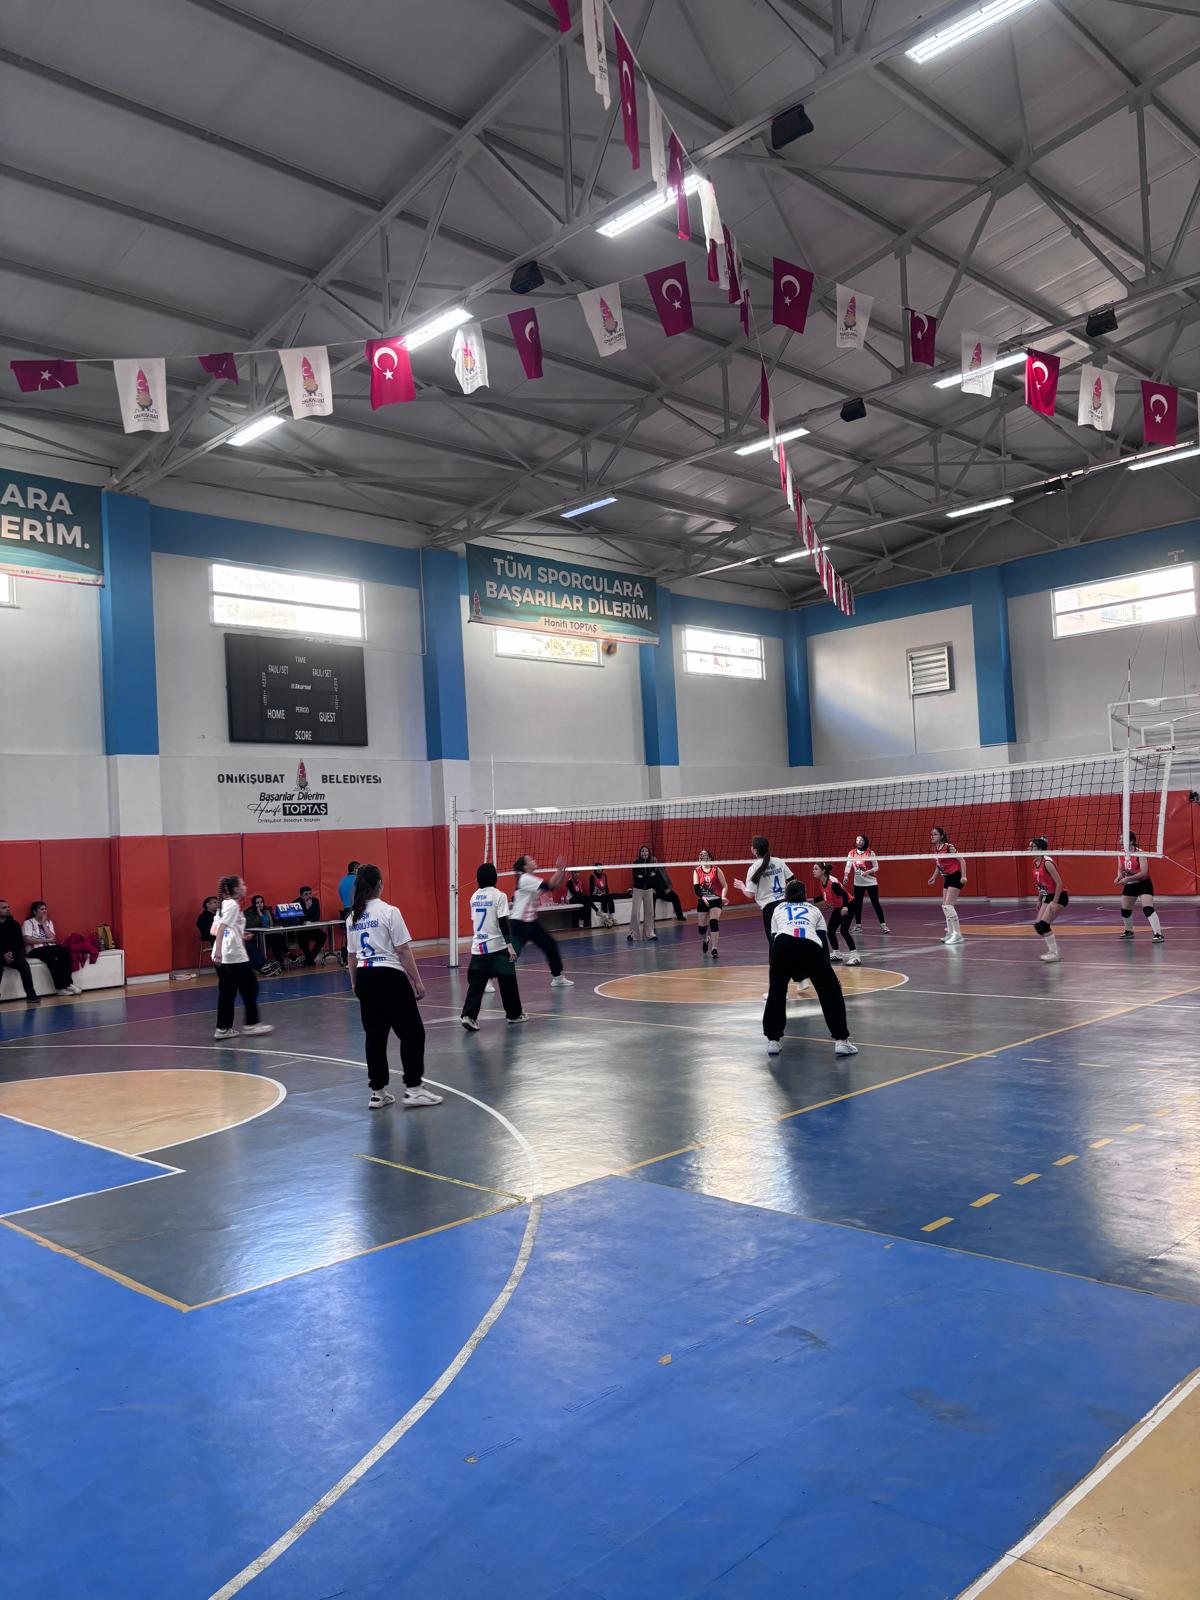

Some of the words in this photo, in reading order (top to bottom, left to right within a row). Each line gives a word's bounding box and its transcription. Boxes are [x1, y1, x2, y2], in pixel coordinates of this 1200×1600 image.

[0, 483, 73, 515] ARA
[0, 514, 91, 550] ERİM.
[492, 555, 532, 581] TÜM
[537, 566, 643, 599] SPORCULARA
[485, 580, 583, 612] BAŞARILAR
[588, 596, 652, 621] DİLERİM.
[544, 618, 568, 629] Hanifi
[569, 622, 597, 633] TOPTAŞ
[294, 655, 306, 664] TIME
[268, 664, 289, 675] FAUL/SET
[312, 668, 332, 678] FAUL/SET
[267, 709, 286, 719] HOME
[319, 712, 336, 723] GUEST
[295, 730, 312, 741] SCORE
[259, 792, 295, 802] Başarılar
[297, 791, 325, 801] Dilerim
[283, 803, 327, 815] TOPTAŞ
[773, 875, 783, 893] 4
[475, 908, 487, 932] 7
[785, 906, 810, 921] 12
